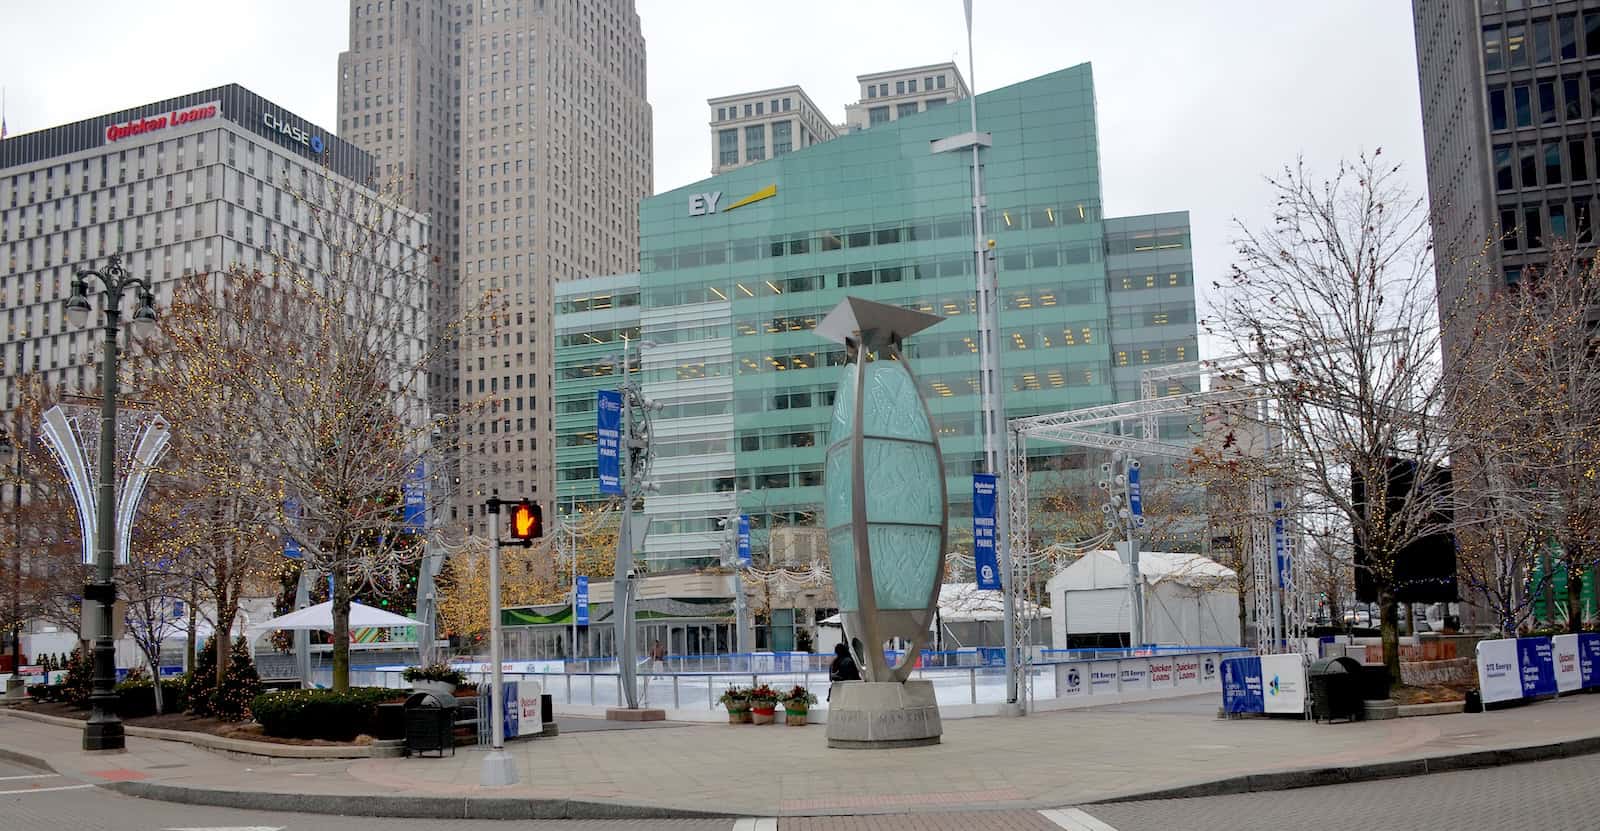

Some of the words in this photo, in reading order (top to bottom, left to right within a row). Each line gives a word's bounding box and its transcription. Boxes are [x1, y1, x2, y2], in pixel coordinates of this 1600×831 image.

[107, 117, 166, 141] Quicken
[170, 106, 216, 126] Loans
[264, 113, 310, 147] CHASE
[688, 192, 722, 216] EY
[1150, 663, 1172, 673] Quicken
[1179, 671, 1196, 680] Loans
[1152, 673, 1170, 682] Loans
